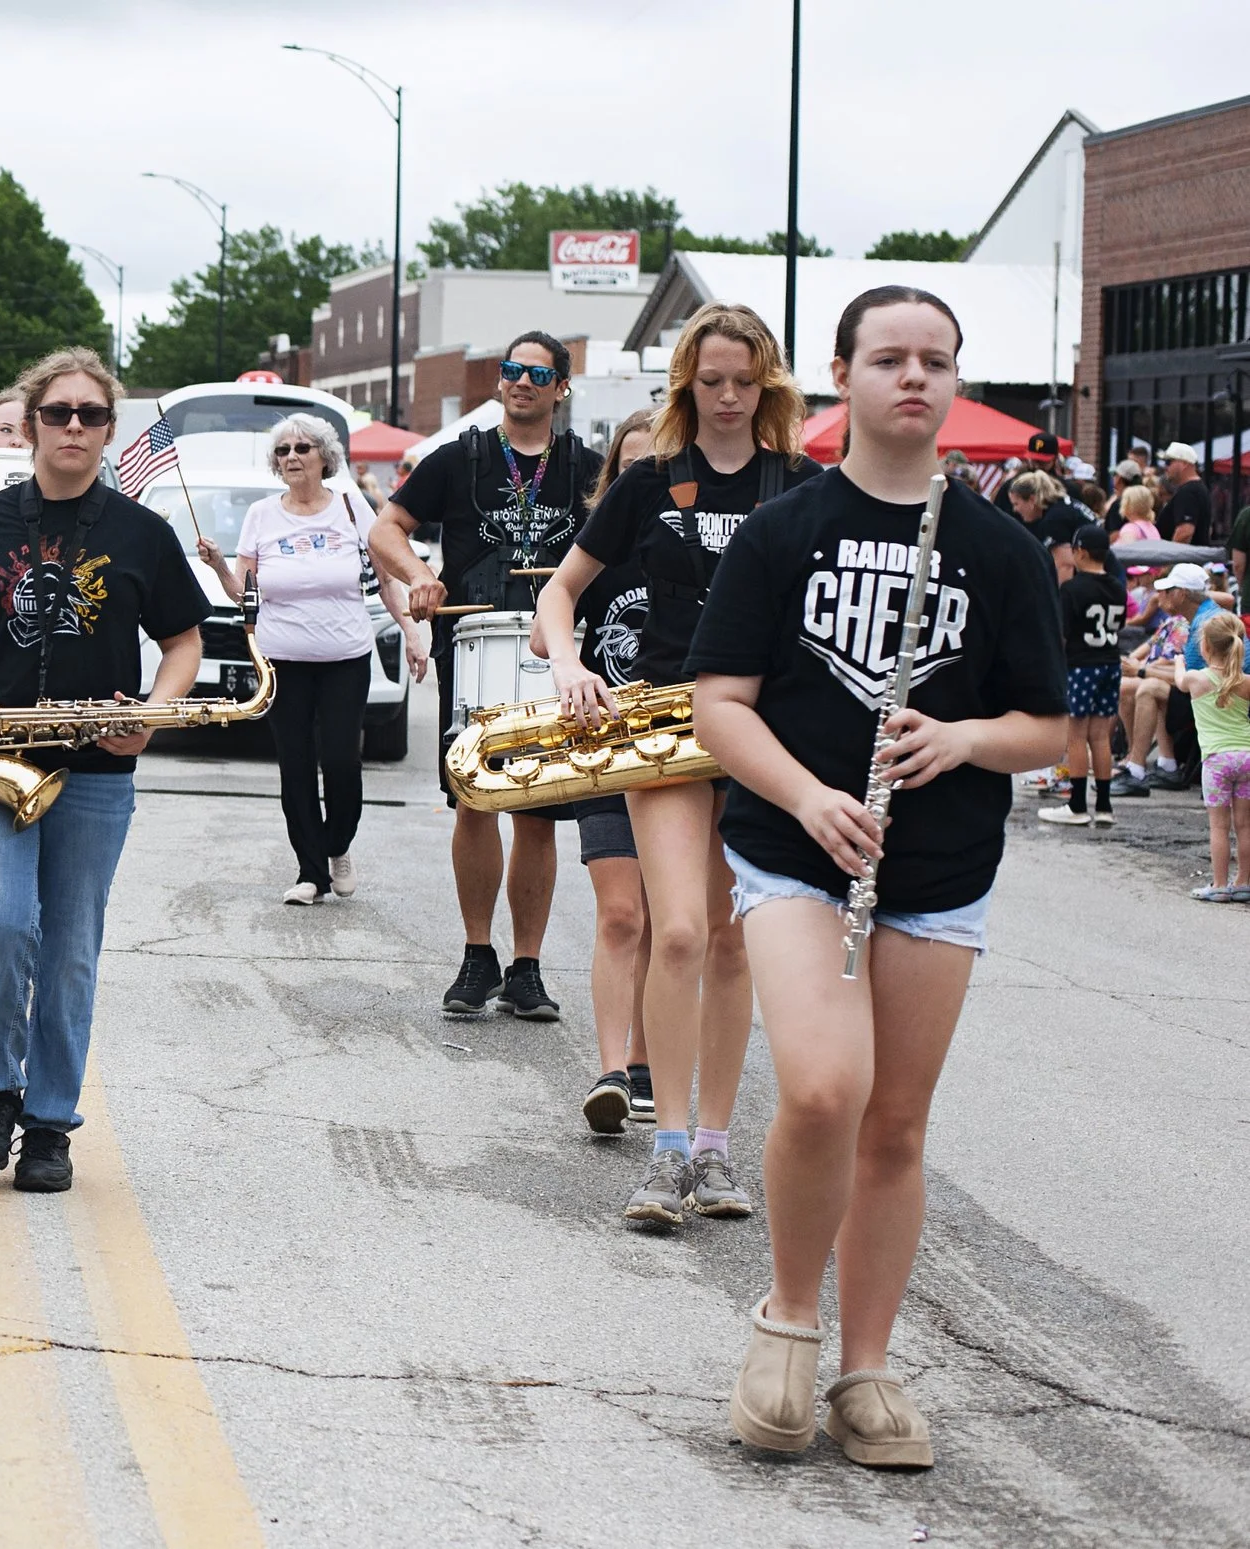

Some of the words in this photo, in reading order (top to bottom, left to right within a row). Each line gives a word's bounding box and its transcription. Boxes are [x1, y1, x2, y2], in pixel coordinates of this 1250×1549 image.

[558, 235, 632, 263] Coca-Cola
[486, 508, 566, 521] RONENA
[1083, 604, 1125, 647] 35
